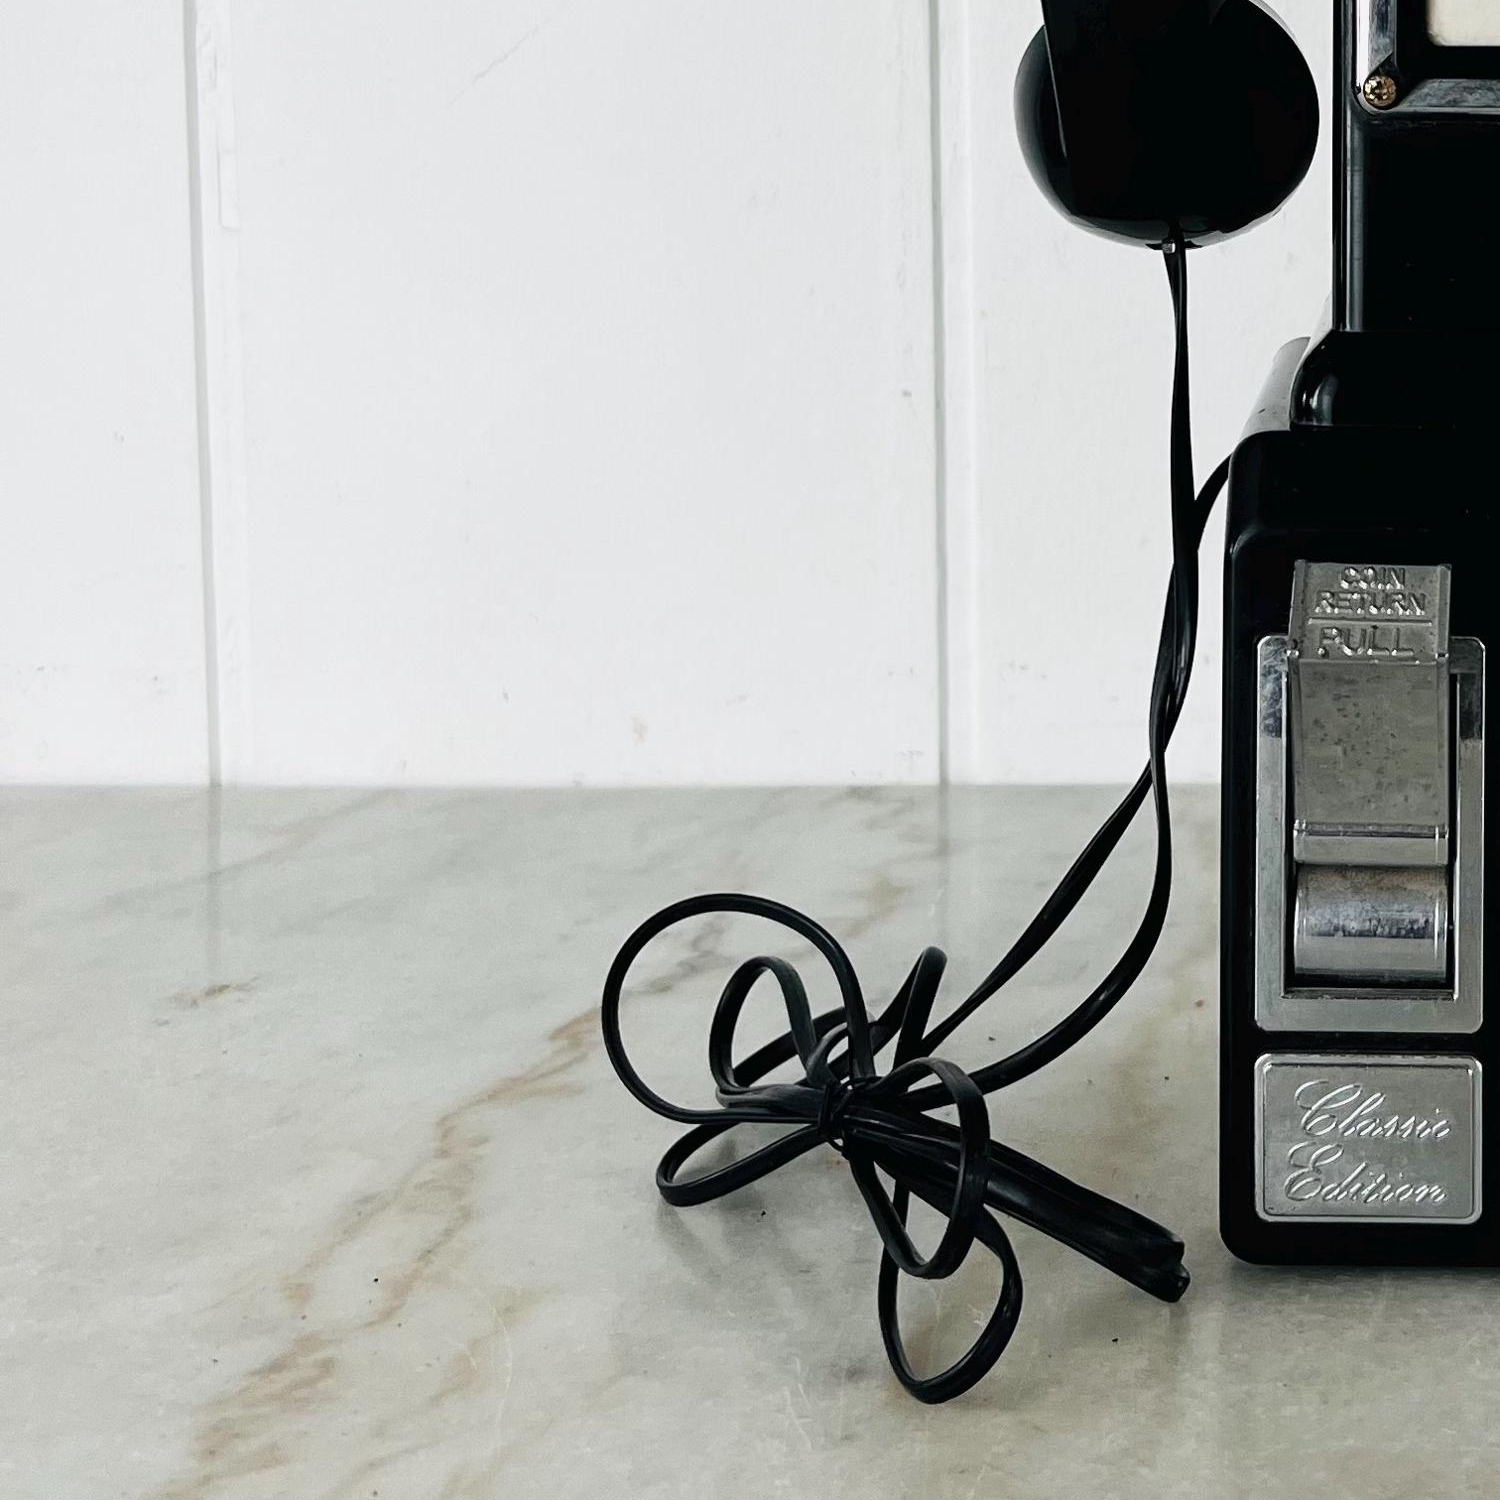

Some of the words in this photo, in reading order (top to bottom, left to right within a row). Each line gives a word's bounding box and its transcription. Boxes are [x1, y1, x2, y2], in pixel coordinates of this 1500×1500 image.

[1341, 566, 1405, 589] COIN
[1315, 590, 1425, 615] RETURN
[1318, 627, 1414, 656] PULL
[1294, 1079, 1450, 1137] Classic
[1285, 1141, 1446, 1203] Edition
